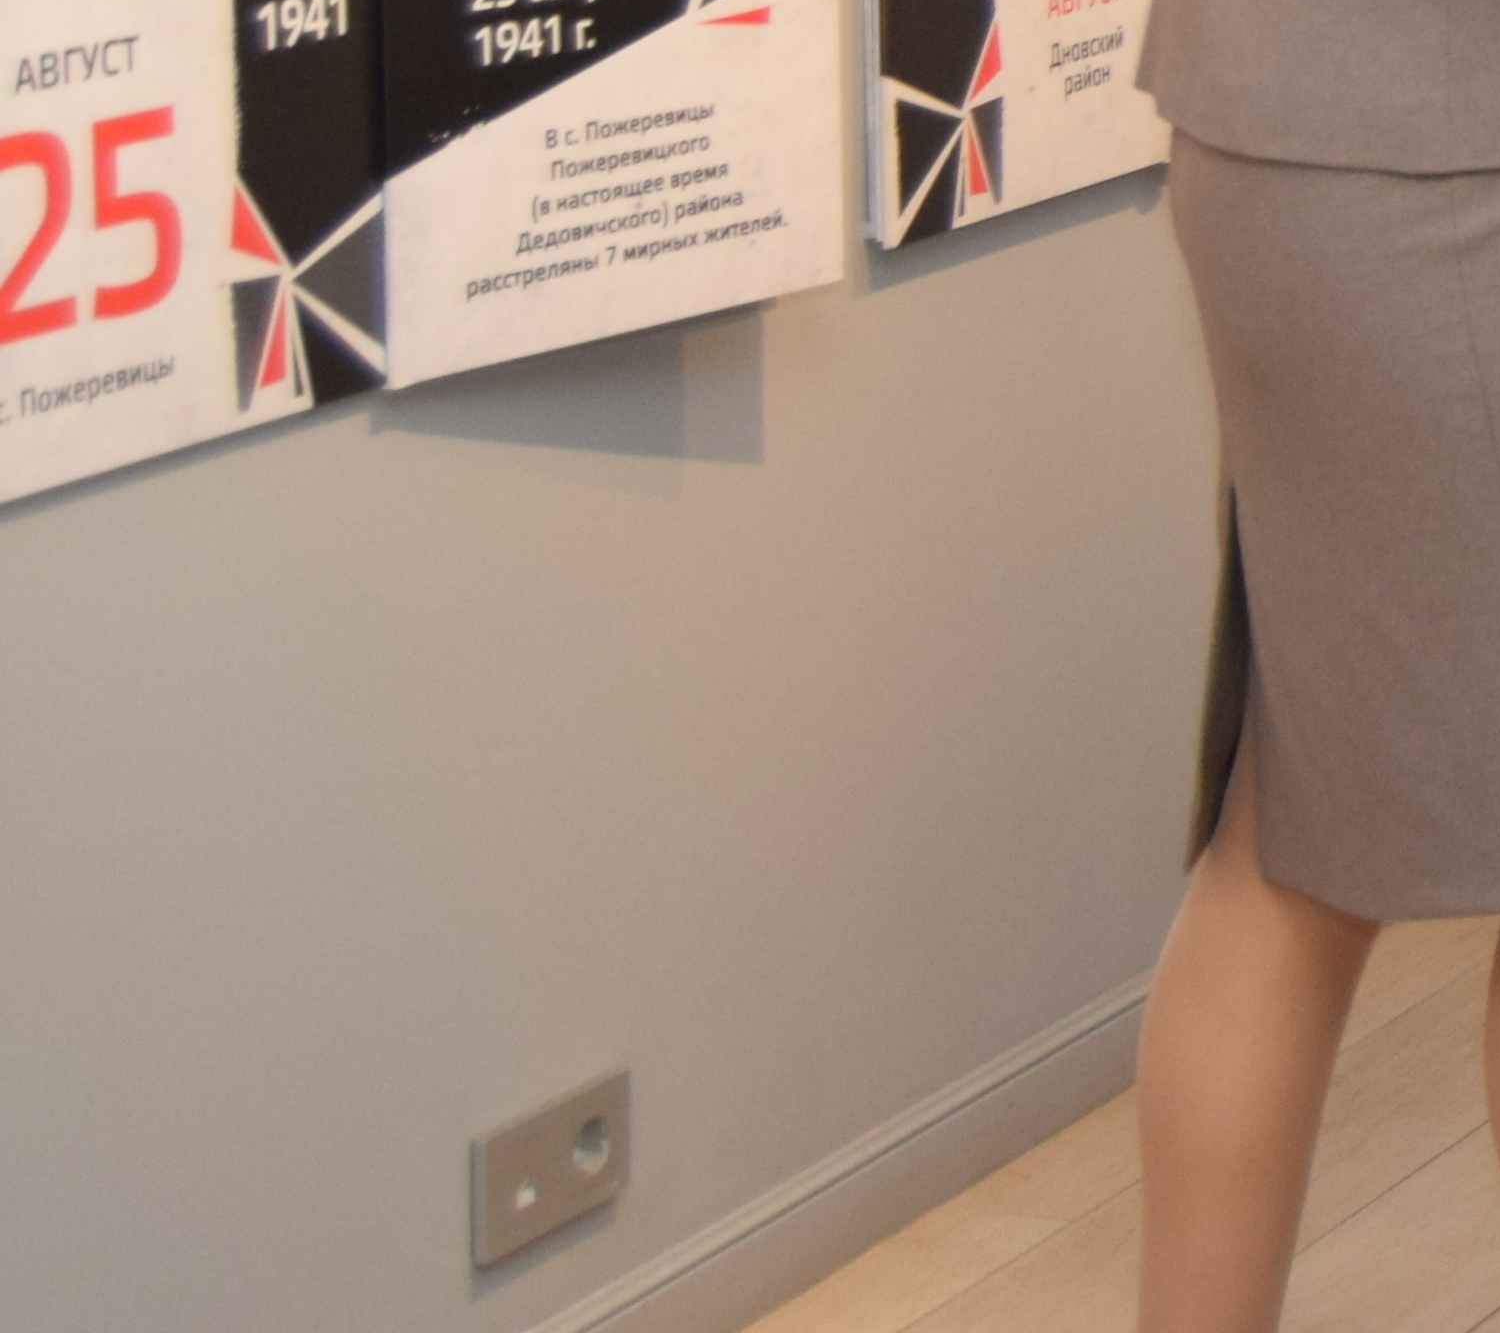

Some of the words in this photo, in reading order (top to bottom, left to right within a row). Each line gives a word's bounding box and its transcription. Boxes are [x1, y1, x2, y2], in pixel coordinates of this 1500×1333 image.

[14, 35, 141, 95] АВГУСТ
[473, 14, 561, 66] 1941
[574, 19, 597, 50] г.
[1049, 25, 1124, 74] Дновский
[1064, 65, 1111, 101] район
[551, 135, 711, 181] Пожеревицкого
[0, 104, 183, 348] 25
[516, 205, 669, 255] Дедовичского)
[674, 189, 744, 222] района
[465, 254, 599, 300] расстреляны
[605, 245, 618, 267] 7
[623, 234, 699, 262] мирных
[703, 209, 788, 245] жителей.
[19, 356, 176, 419] Пожеревицы
